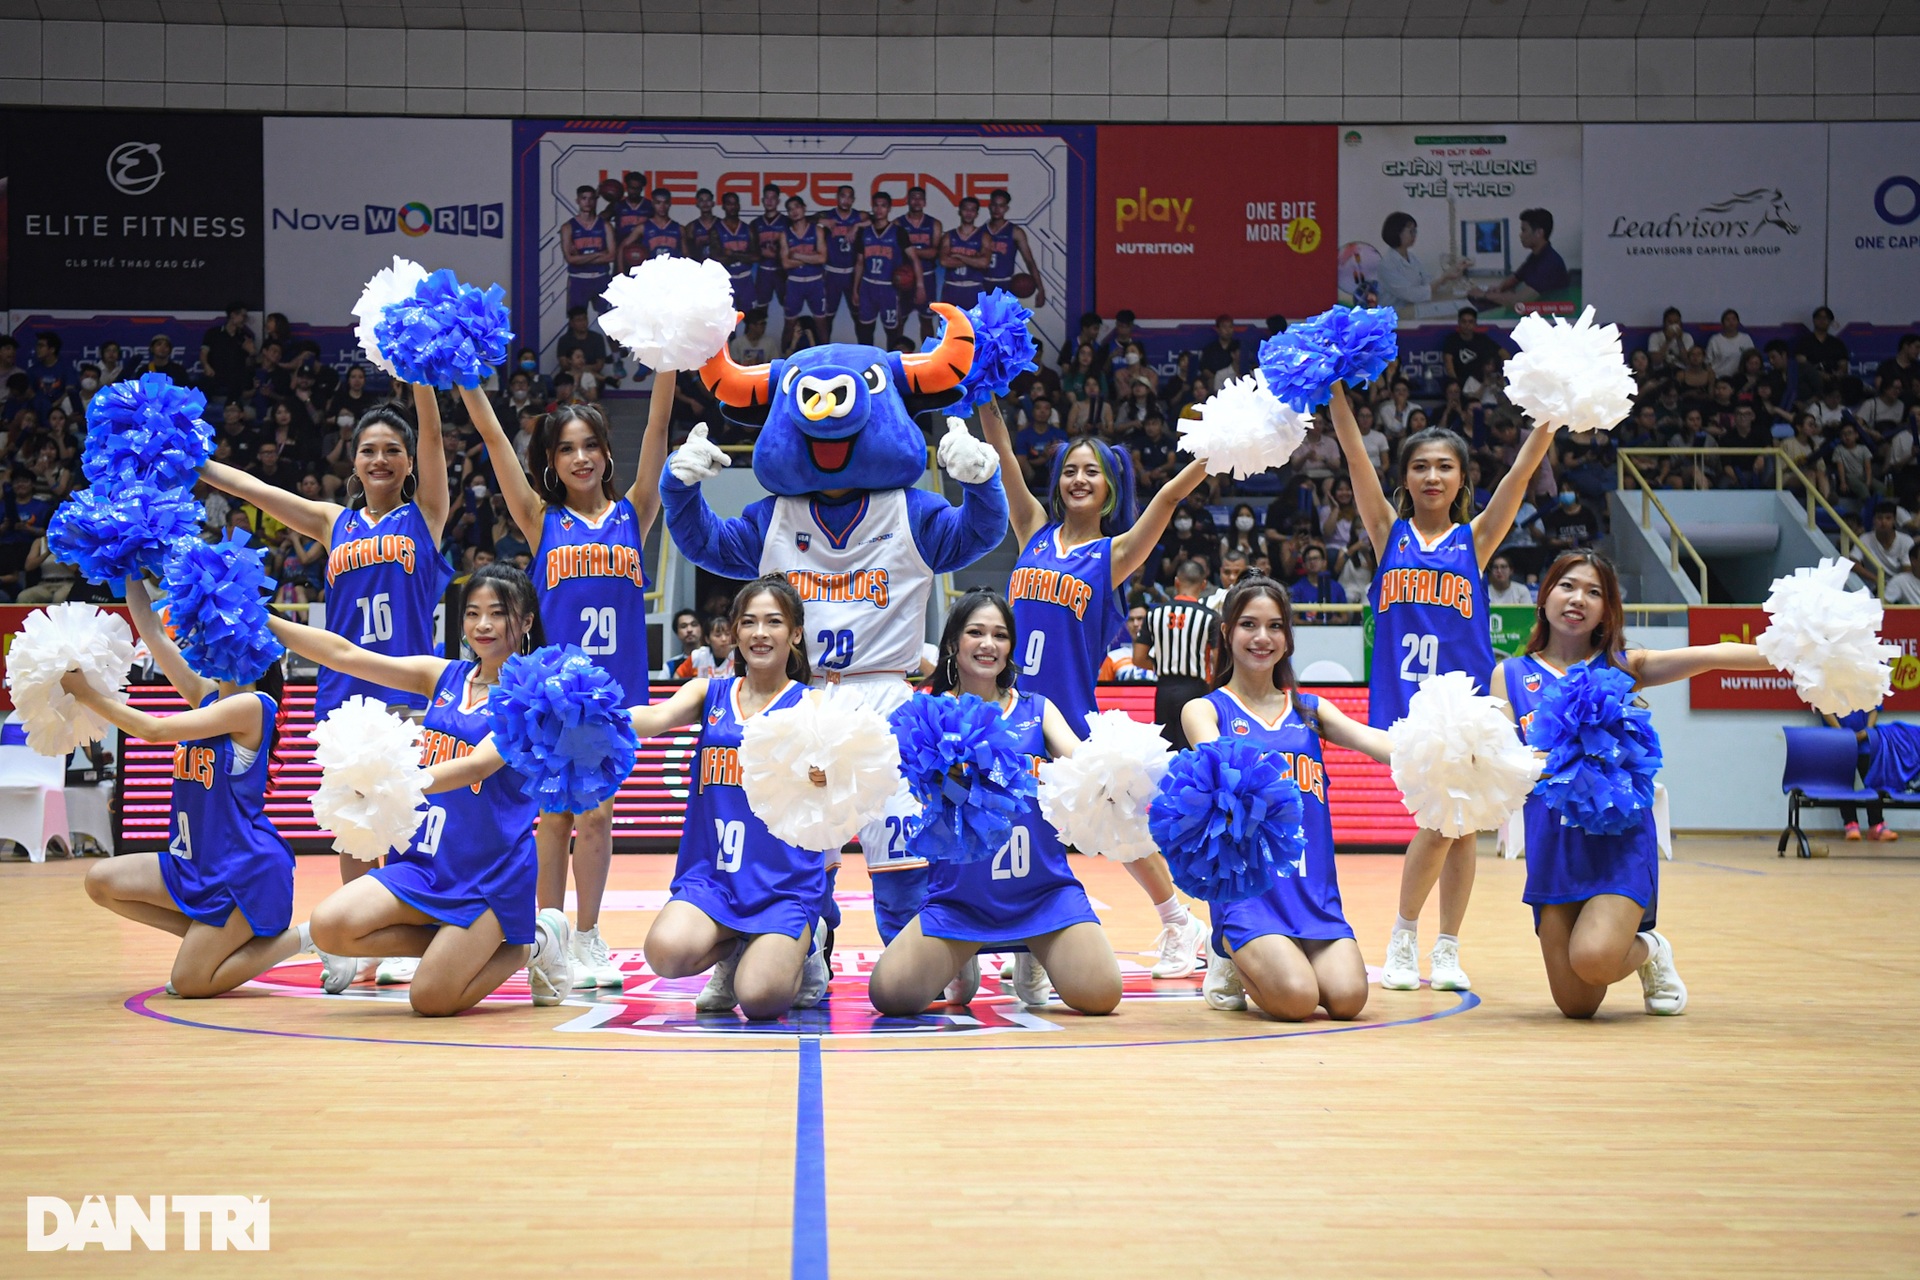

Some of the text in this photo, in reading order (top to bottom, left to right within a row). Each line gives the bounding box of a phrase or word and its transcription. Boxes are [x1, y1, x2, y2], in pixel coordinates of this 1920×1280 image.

[716, 171, 853, 207] ARE
[871, 173, 1009, 208] ONE
[1453, 182, 1514, 197] THAO
[26, 215, 246, 238] ELITE FITNESS
[1246, 201, 1317, 221] ONE BITE
[1608, 213, 1749, 238] Leadvisors
[1116, 243, 1194, 255] NUTRITION
[1626, 246, 1781, 256] LEADVISORS CAPITAL GROUP
[1855, 236, 1885, 249] ONE
[65, 259, 88, 268] CLB
[120, 259, 151, 269] THAO
[155, 260, 178, 269] CAO
[871, 258, 883, 274] 12
[547, 543, 643, 590] BUFFALOES
[785, 568, 890, 609] BUFFALOES
[1009, 567, 1092, 621] BUFFALOES
[1379, 570, 1473, 619] BUFFALOES
[356, 592, 393, 645] 16
[580, 607, 617, 655] 29
[1167, 612, 1186, 629] 38
[817, 629, 854, 669] 29
[1401, 633, 1439, 681] 29
[991, 825, 1030, 880] 20
